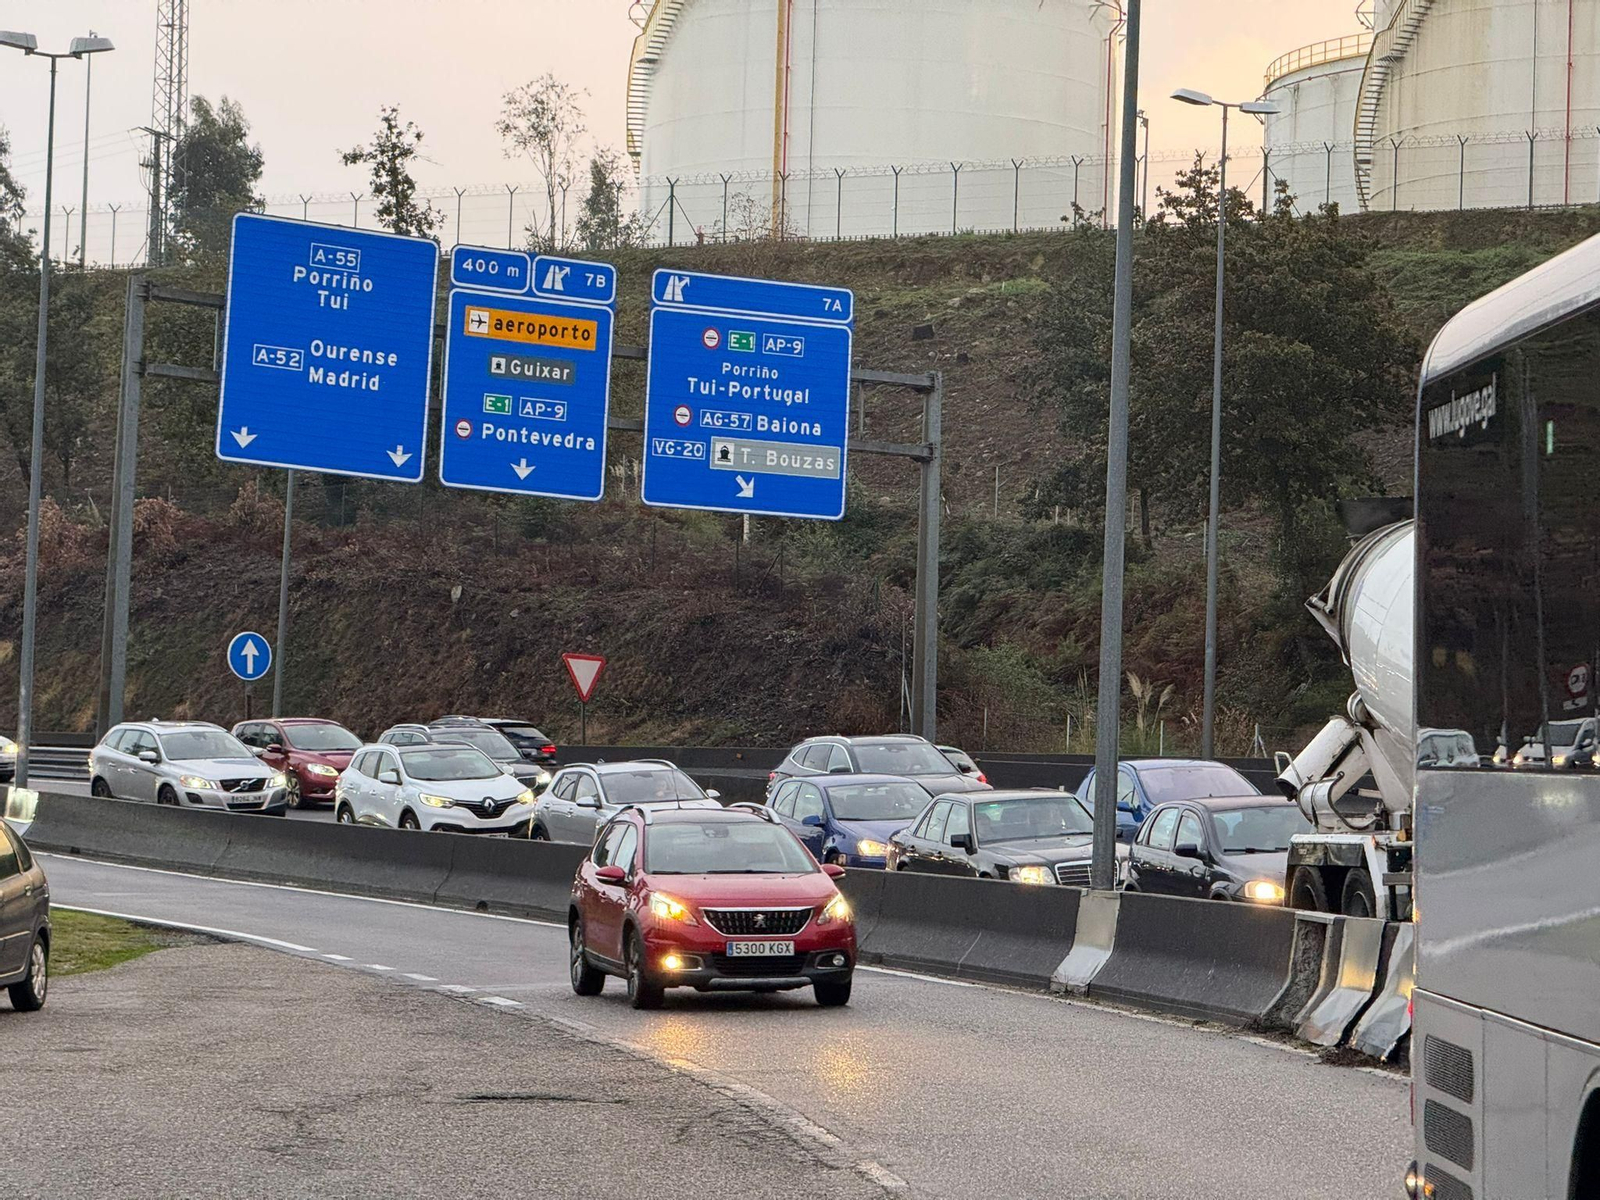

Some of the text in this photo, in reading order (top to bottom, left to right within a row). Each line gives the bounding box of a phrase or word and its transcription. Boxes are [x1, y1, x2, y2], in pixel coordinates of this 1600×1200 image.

[314, 249, 357, 268] A-55
[462, 258, 519, 277] 400 m
[293, 266, 373, 292] Porriño
[585, 273, 606, 288] 7B
[318, 290, 348, 310] Tui
[823, 298, 842, 312] 7A
[494, 317, 591, 341] aeroporto
[310, 339, 398, 366] Ourense
[730, 335, 802, 354] E-1 AP-9
[256, 348, 301, 367] A-52
[308, 366, 380, 391] Madrid
[510, 360, 570, 380] Guixar
[722, 363, 779, 379] Porriño
[687, 377, 809, 406] Tui-Portugal
[485, 397, 564, 418] E-1 AP-9
[702, 413, 821, 436] AG-57 Baiona
[482, 423, 595, 450] Pontevedra
[655, 440, 835, 470] VG-20 T. Bouzas
[735, 943, 791, 954] 5300 KGX
